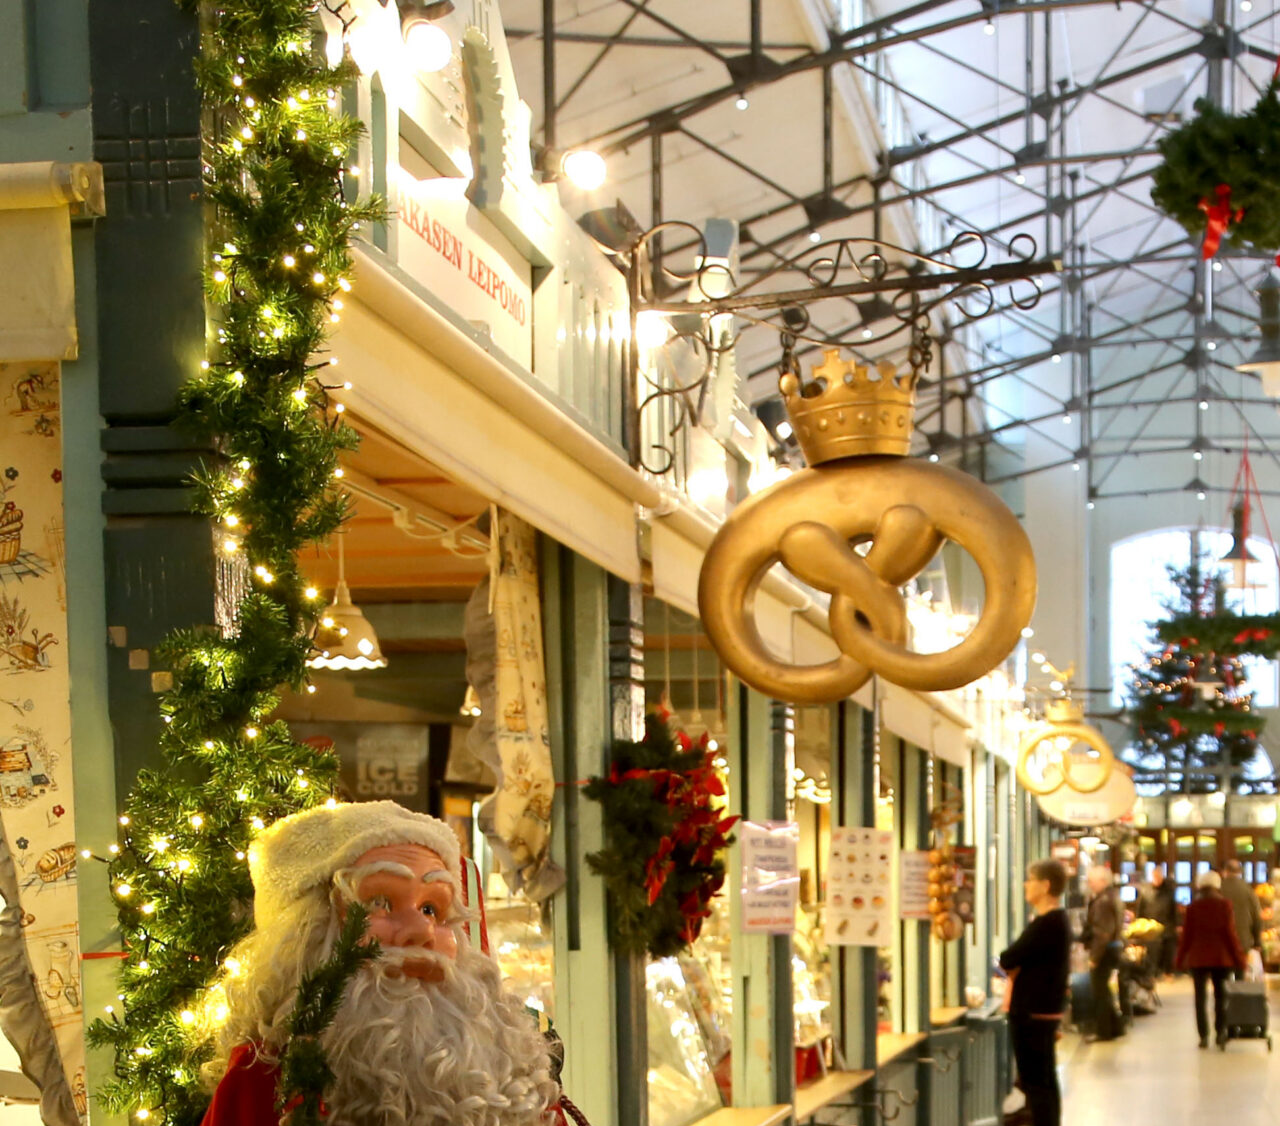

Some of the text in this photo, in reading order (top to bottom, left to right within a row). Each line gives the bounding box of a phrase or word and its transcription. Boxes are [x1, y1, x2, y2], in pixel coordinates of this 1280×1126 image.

[397, 192, 526, 327] AKASEN LEIPOMO
[357, 758, 419, 781] ICE
[357, 781, 420, 796] COLD
